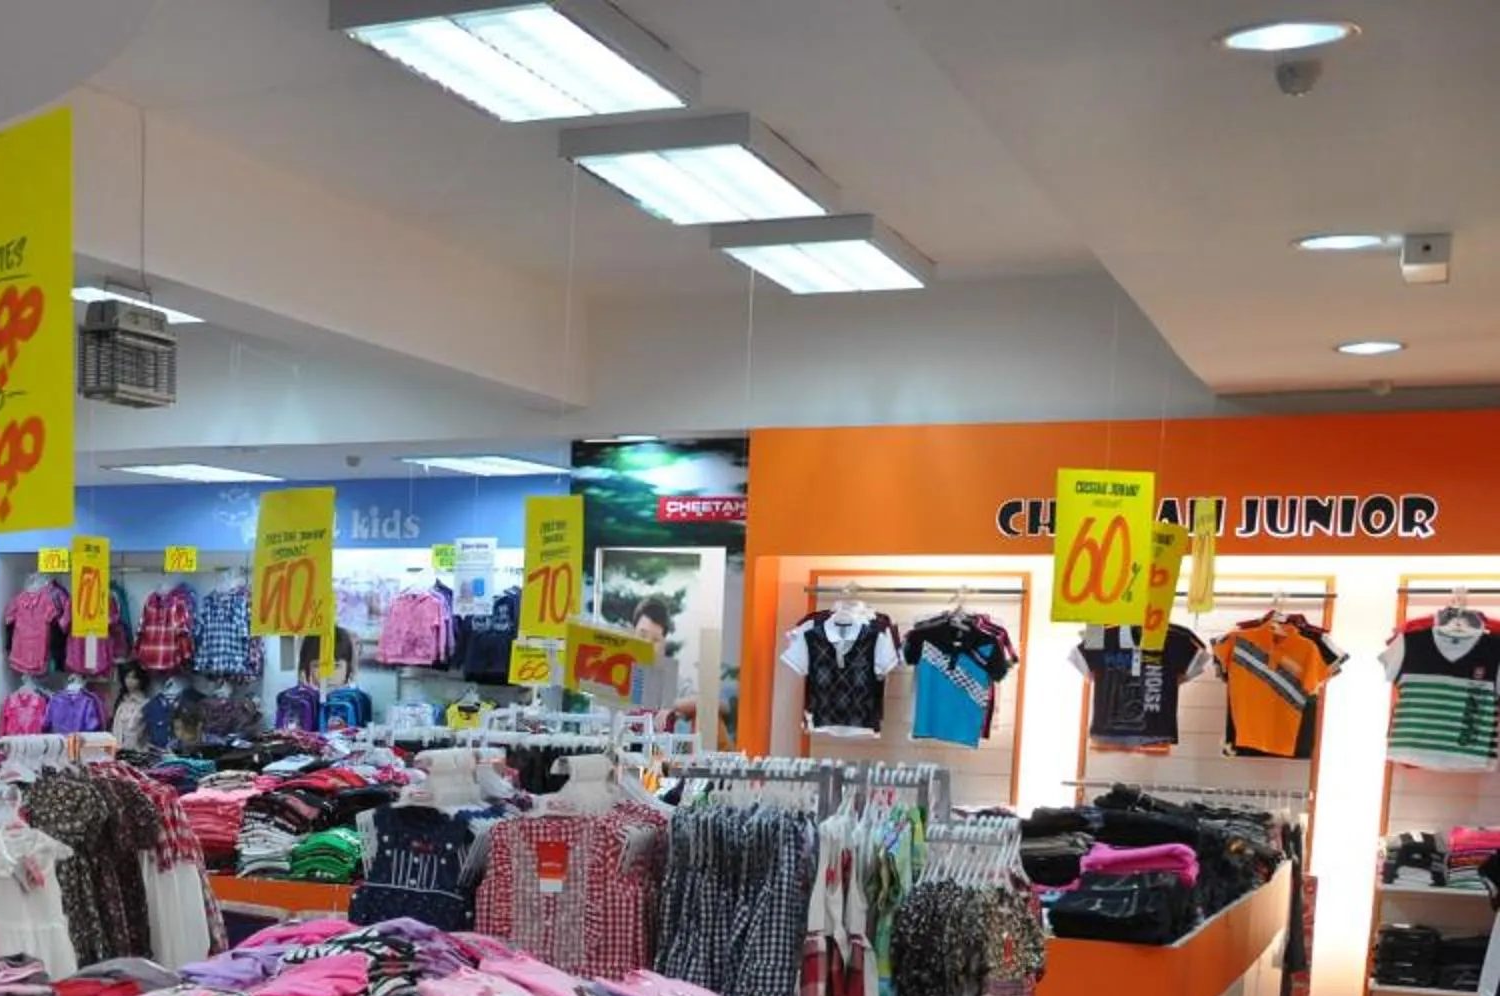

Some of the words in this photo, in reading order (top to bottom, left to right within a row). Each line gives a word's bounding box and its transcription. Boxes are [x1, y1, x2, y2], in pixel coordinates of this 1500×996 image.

[352, 505, 421, 540] kids
[665, 500, 747, 514] CHEETAH
[1235, 493, 1439, 539] JUNIOR
